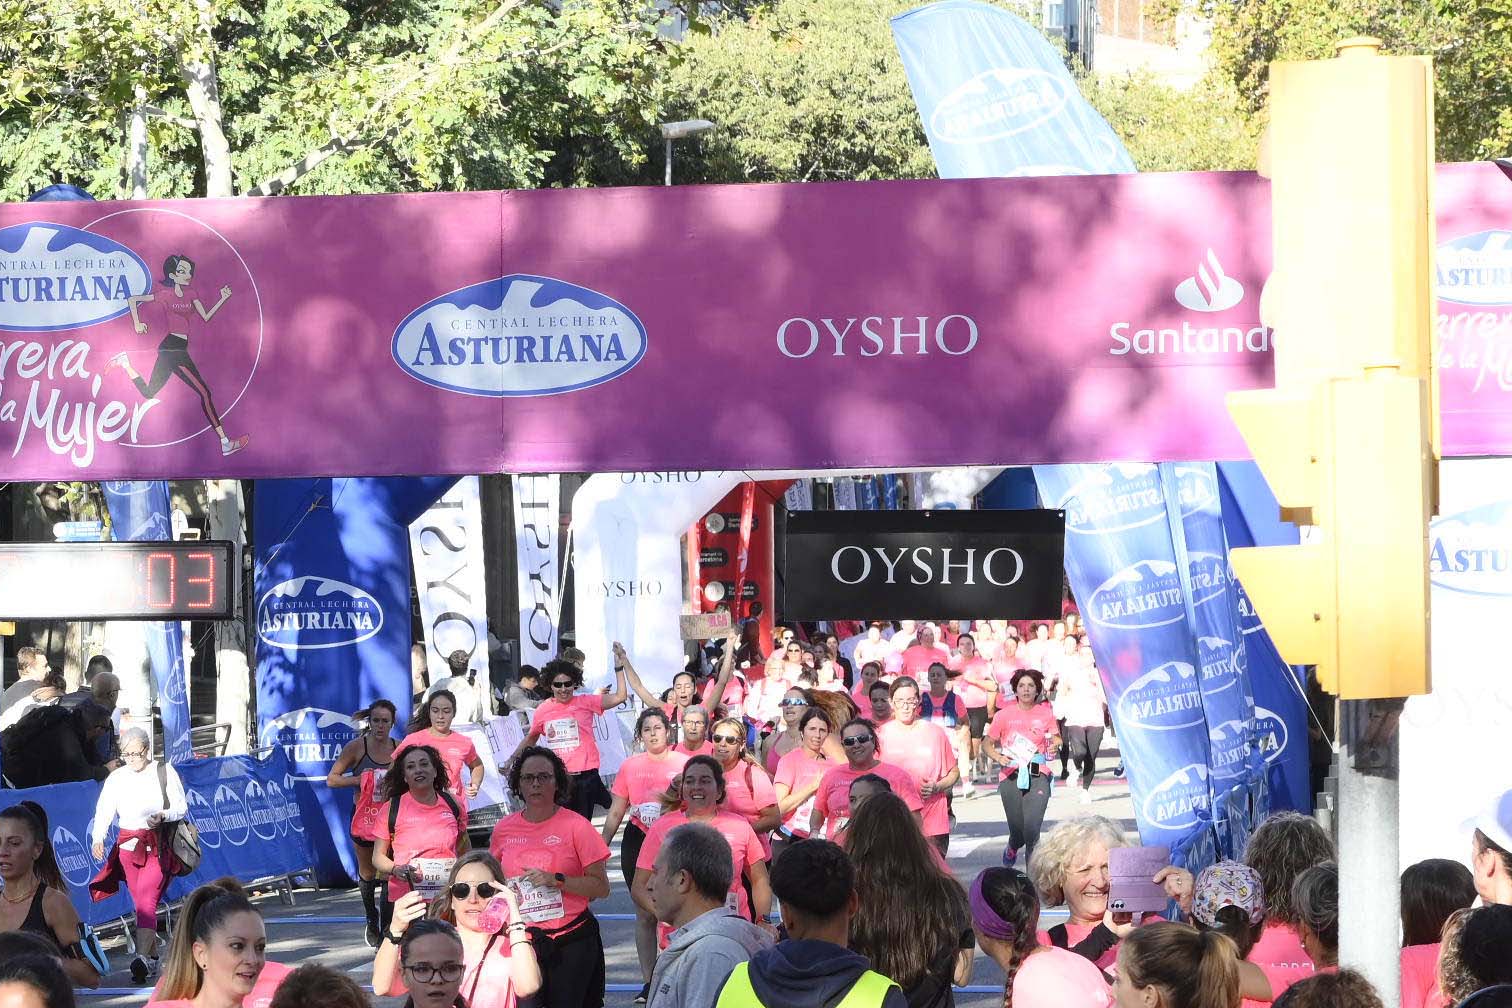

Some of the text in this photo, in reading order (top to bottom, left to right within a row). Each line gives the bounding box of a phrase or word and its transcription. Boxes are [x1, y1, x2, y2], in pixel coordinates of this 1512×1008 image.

[54, 258, 126, 270] LECHERA
[451, 316, 619, 331] CENTRAL LECHERA
[775, 313, 980, 359] OYSHO
[412, 322, 628, 367] ASTURIANA
[12, 374, 163, 468] Mujer
[830, 545, 1024, 587] OYSHO
[261, 606, 374, 632] ASTURIANA
[273, 599, 370, 610] CENTRAL LECHERA
